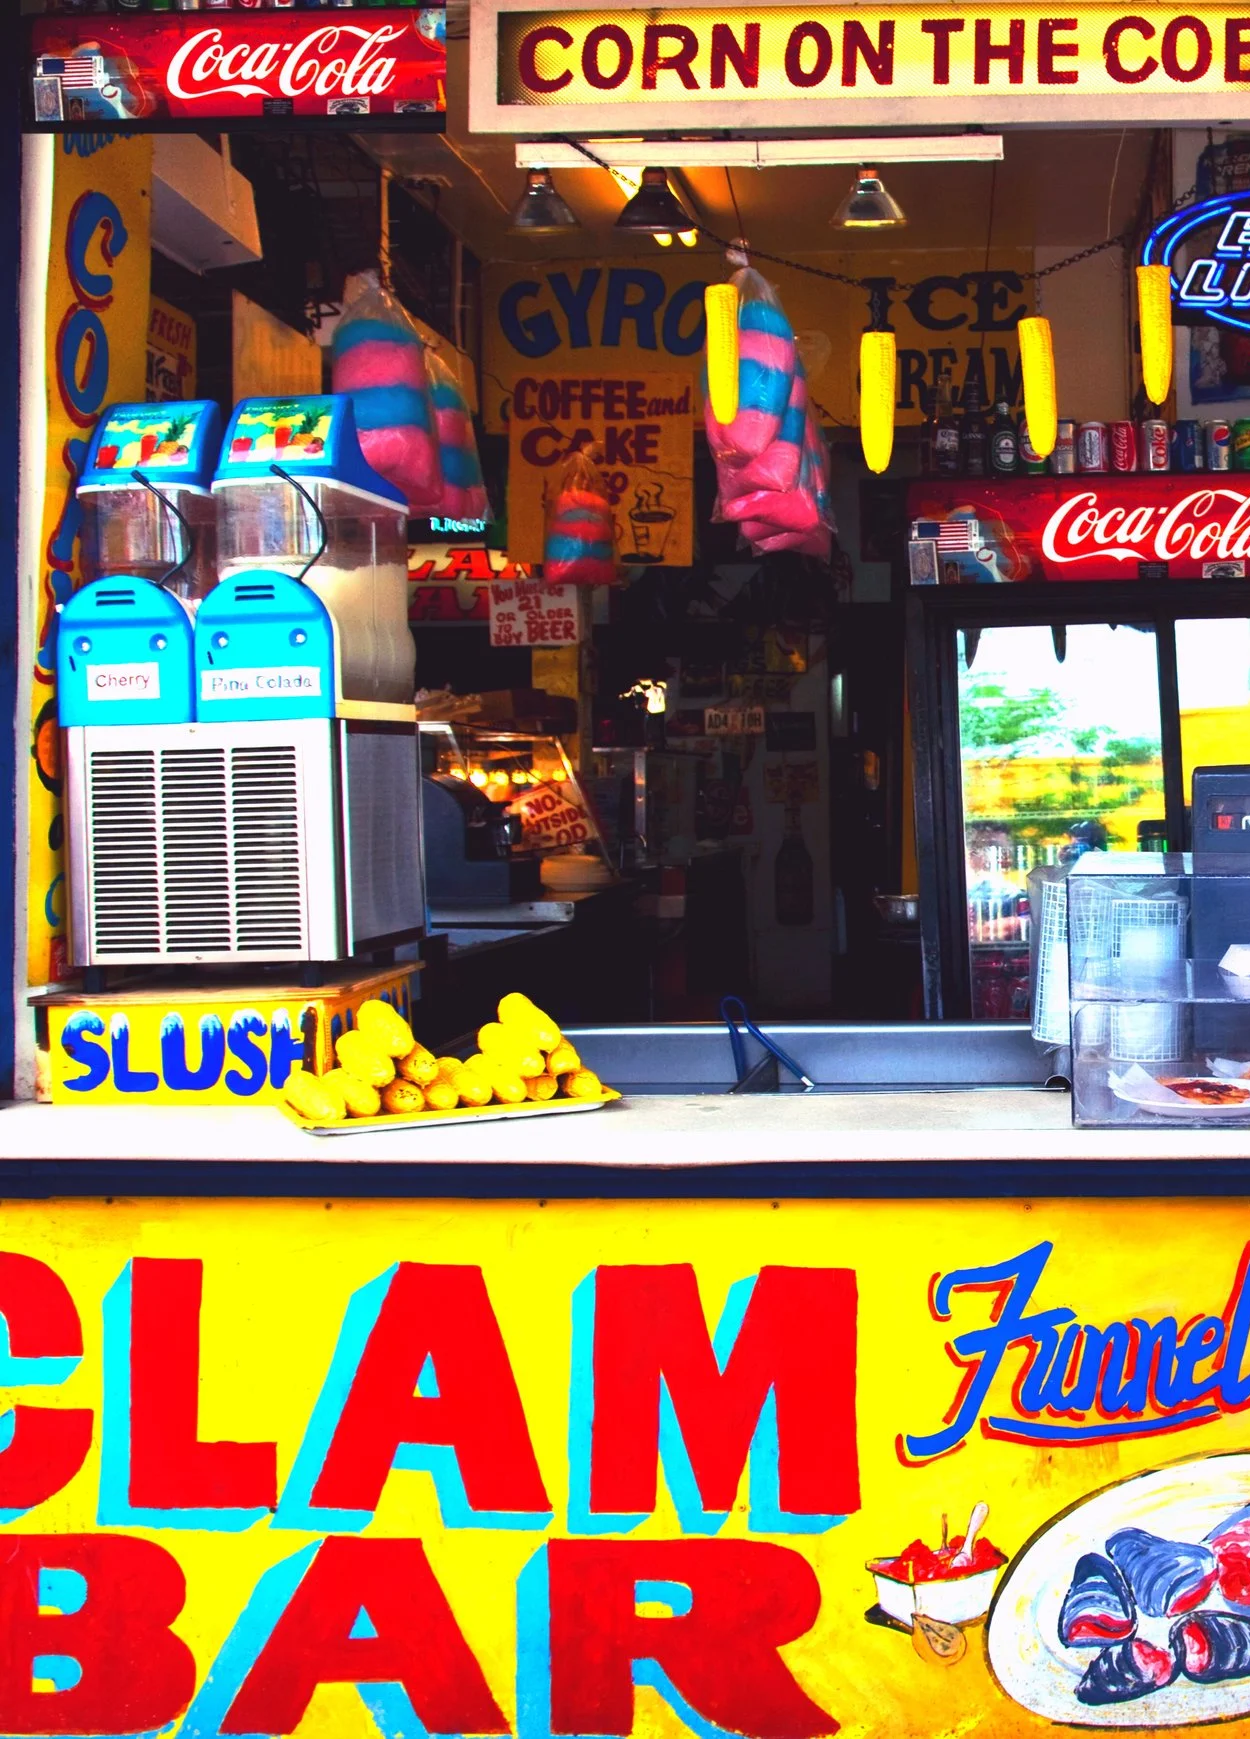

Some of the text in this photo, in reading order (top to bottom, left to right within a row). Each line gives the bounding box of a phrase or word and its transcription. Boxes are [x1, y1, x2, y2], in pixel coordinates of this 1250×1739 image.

[167, 24, 409, 100] Coca-Cola
[518, 22, 760, 93] CORN
[786, 19, 896, 89] ON
[922, 18, 1081, 87] THE
[861, 271, 1028, 333] ICE
[513, 377, 690, 420] COFFEE and
[520, 424, 661, 467] CAKE
[496, 608, 574, 623] OR OLDER
[518, 595, 542, 612] 21
[494, 620, 577, 645] BUY BEER
[95, 672, 151, 693] Cherry
[256, 674, 312, 690] Colada
[61, 1006, 319, 1097] SLUSH
[0, 1252, 863, 1534] CLAM
[0, 1533, 842, 1739] BAR
